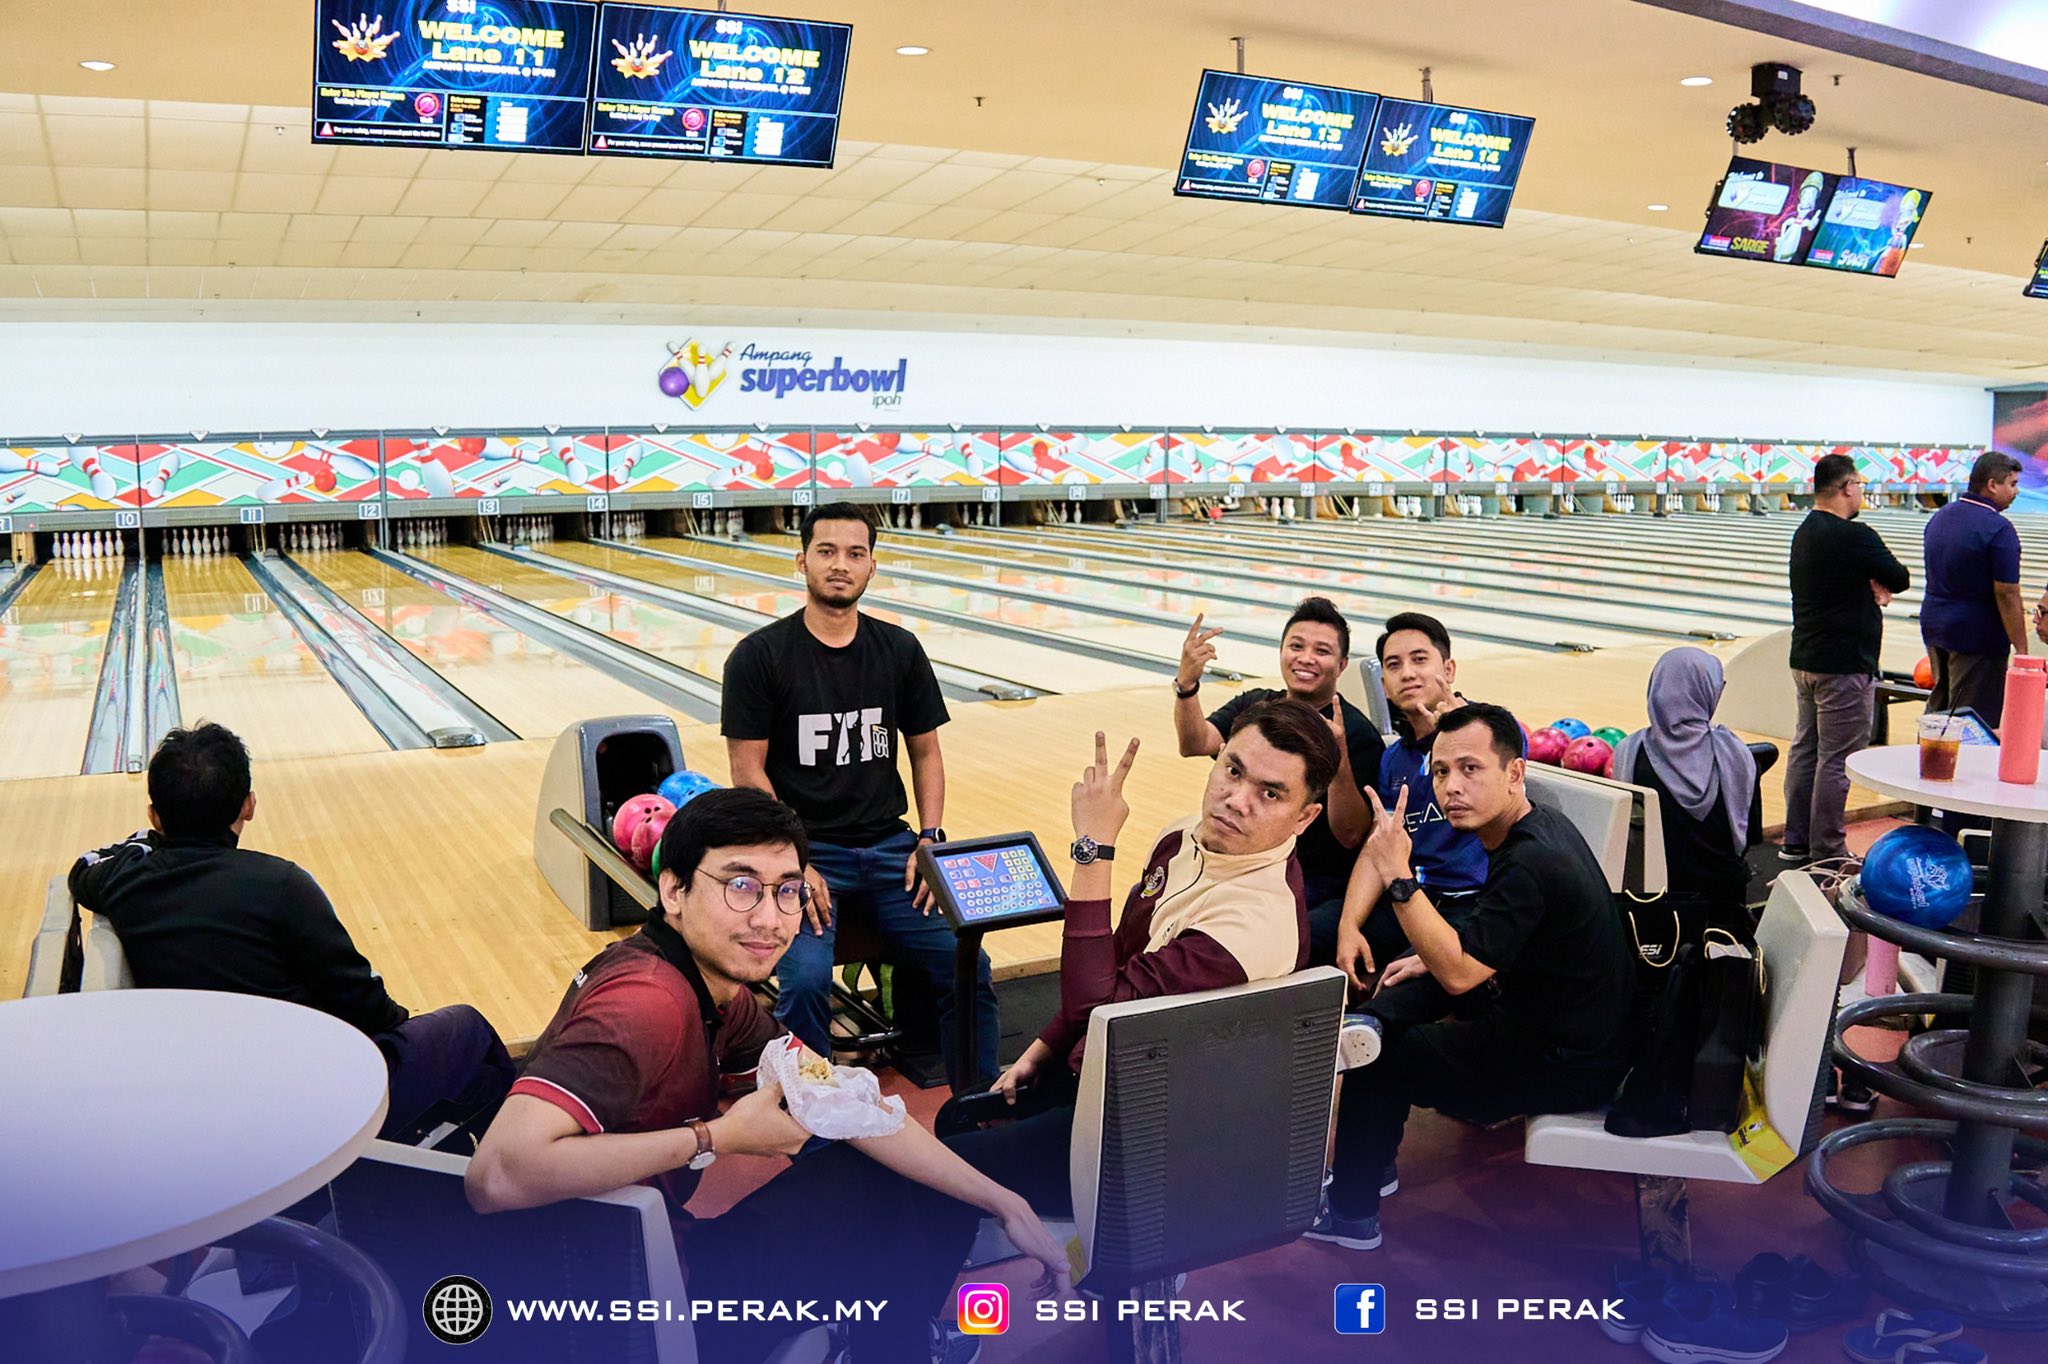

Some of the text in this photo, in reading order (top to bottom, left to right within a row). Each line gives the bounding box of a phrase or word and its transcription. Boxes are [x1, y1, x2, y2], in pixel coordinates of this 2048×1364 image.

[418, 20, 564, 48] WELCOME
[432, 42, 545, 67] Lane 11
[688, 40, 820, 68] WELCOME
[700, 60, 806, 85] Lane 12
[1262, 103, 1355, 129] WELCOME
[1266, 119, 1312, 139] Lane
[1318, 128, 1342, 143] 13
[1430, 127, 1512, 151] WELCOME
[1433, 143, 1474, 161] Lane
[1479, 149, 1500, 164] 14
[740, 343, 813, 367] Ampang
[740, 357, 907, 399] superbowl
[872, 391, 902, 409] ipoh
[481, 500, 495, 513] 13
[591, 497, 605, 511] 14
[697, 494, 709, 506] 15
[797, 491, 809, 503] 16
[896, 490, 907, 502] 17
[121, 514, 134, 526] 10
[247, 509, 257, 522] 11
[363, 504, 377, 517] 12
